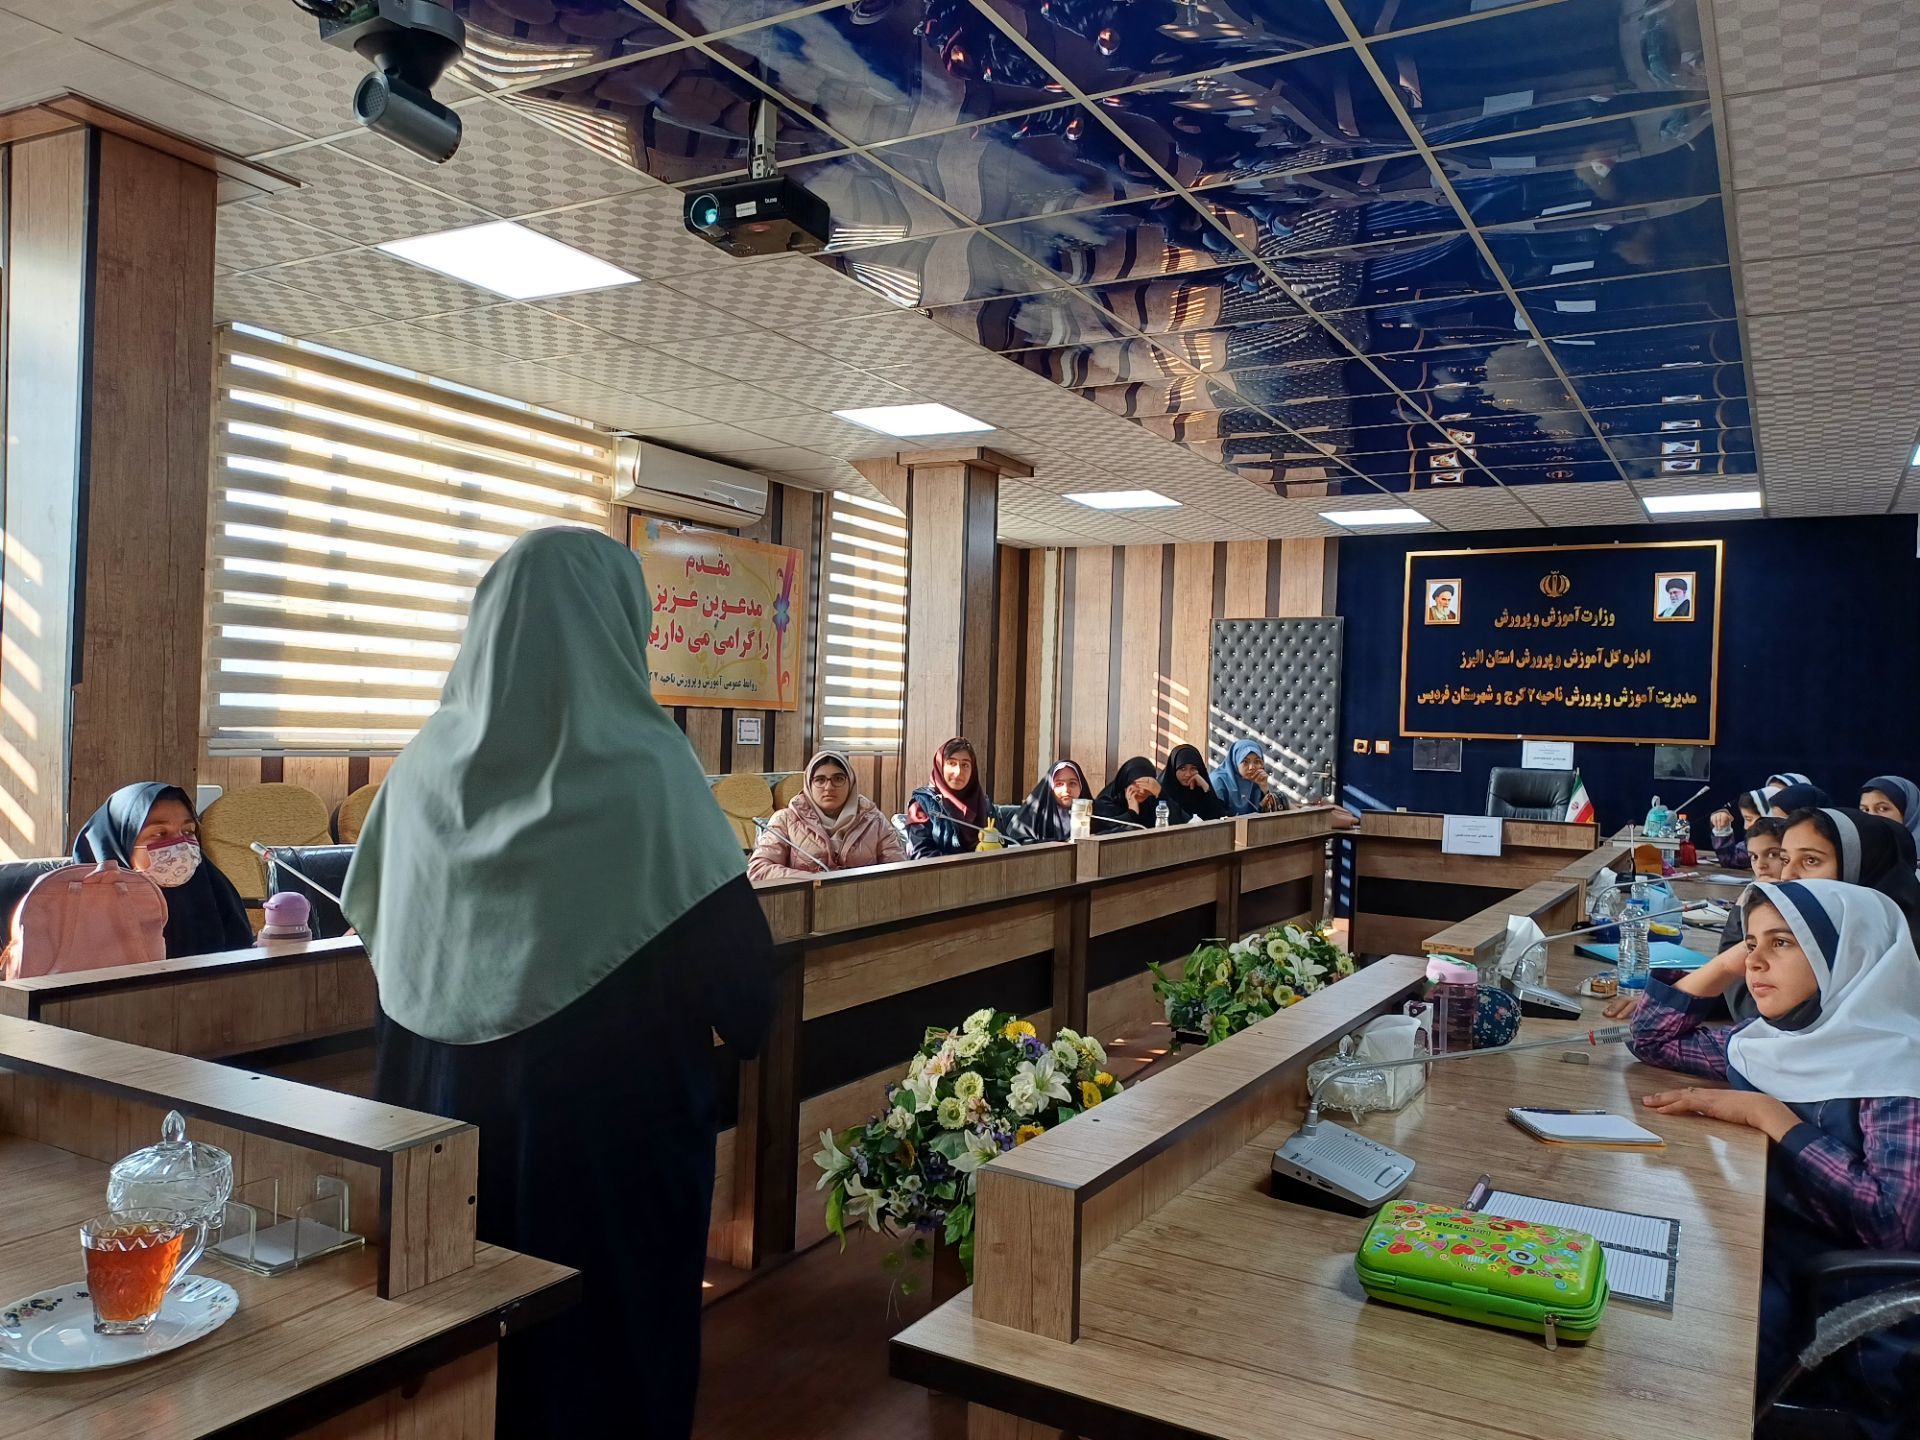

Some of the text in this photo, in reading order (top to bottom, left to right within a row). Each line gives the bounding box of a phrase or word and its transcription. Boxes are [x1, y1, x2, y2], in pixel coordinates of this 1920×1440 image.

[685, 553, 731, 578] مقدم
[653, 584, 762, 620] مدعوین عزیز
[1494, 606, 1615, 629] وزارت آموزش و پرورش
[687, 632, 710, 653] می
[713, 627, 755, 658] گرامی
[758, 630, 769, 660] را
[1459, 647, 1651, 671] اداره کل آموزش و پرورش استان البرز
[1417, 684, 1450, 705] فردیس
[1451, 684, 1494, 706] شهرستان
[1495, 692, 1502, 706] و
[1503, 687, 1527, 706] کرج
[1536, 686, 1563, 706] ناحیه
[1565, 686, 1603, 709] پرورش
[1604, 692, 1611, 707] و
[1613, 686, 1655, 708] آموزش
[1655, 691, 1697, 708] مدیریت
